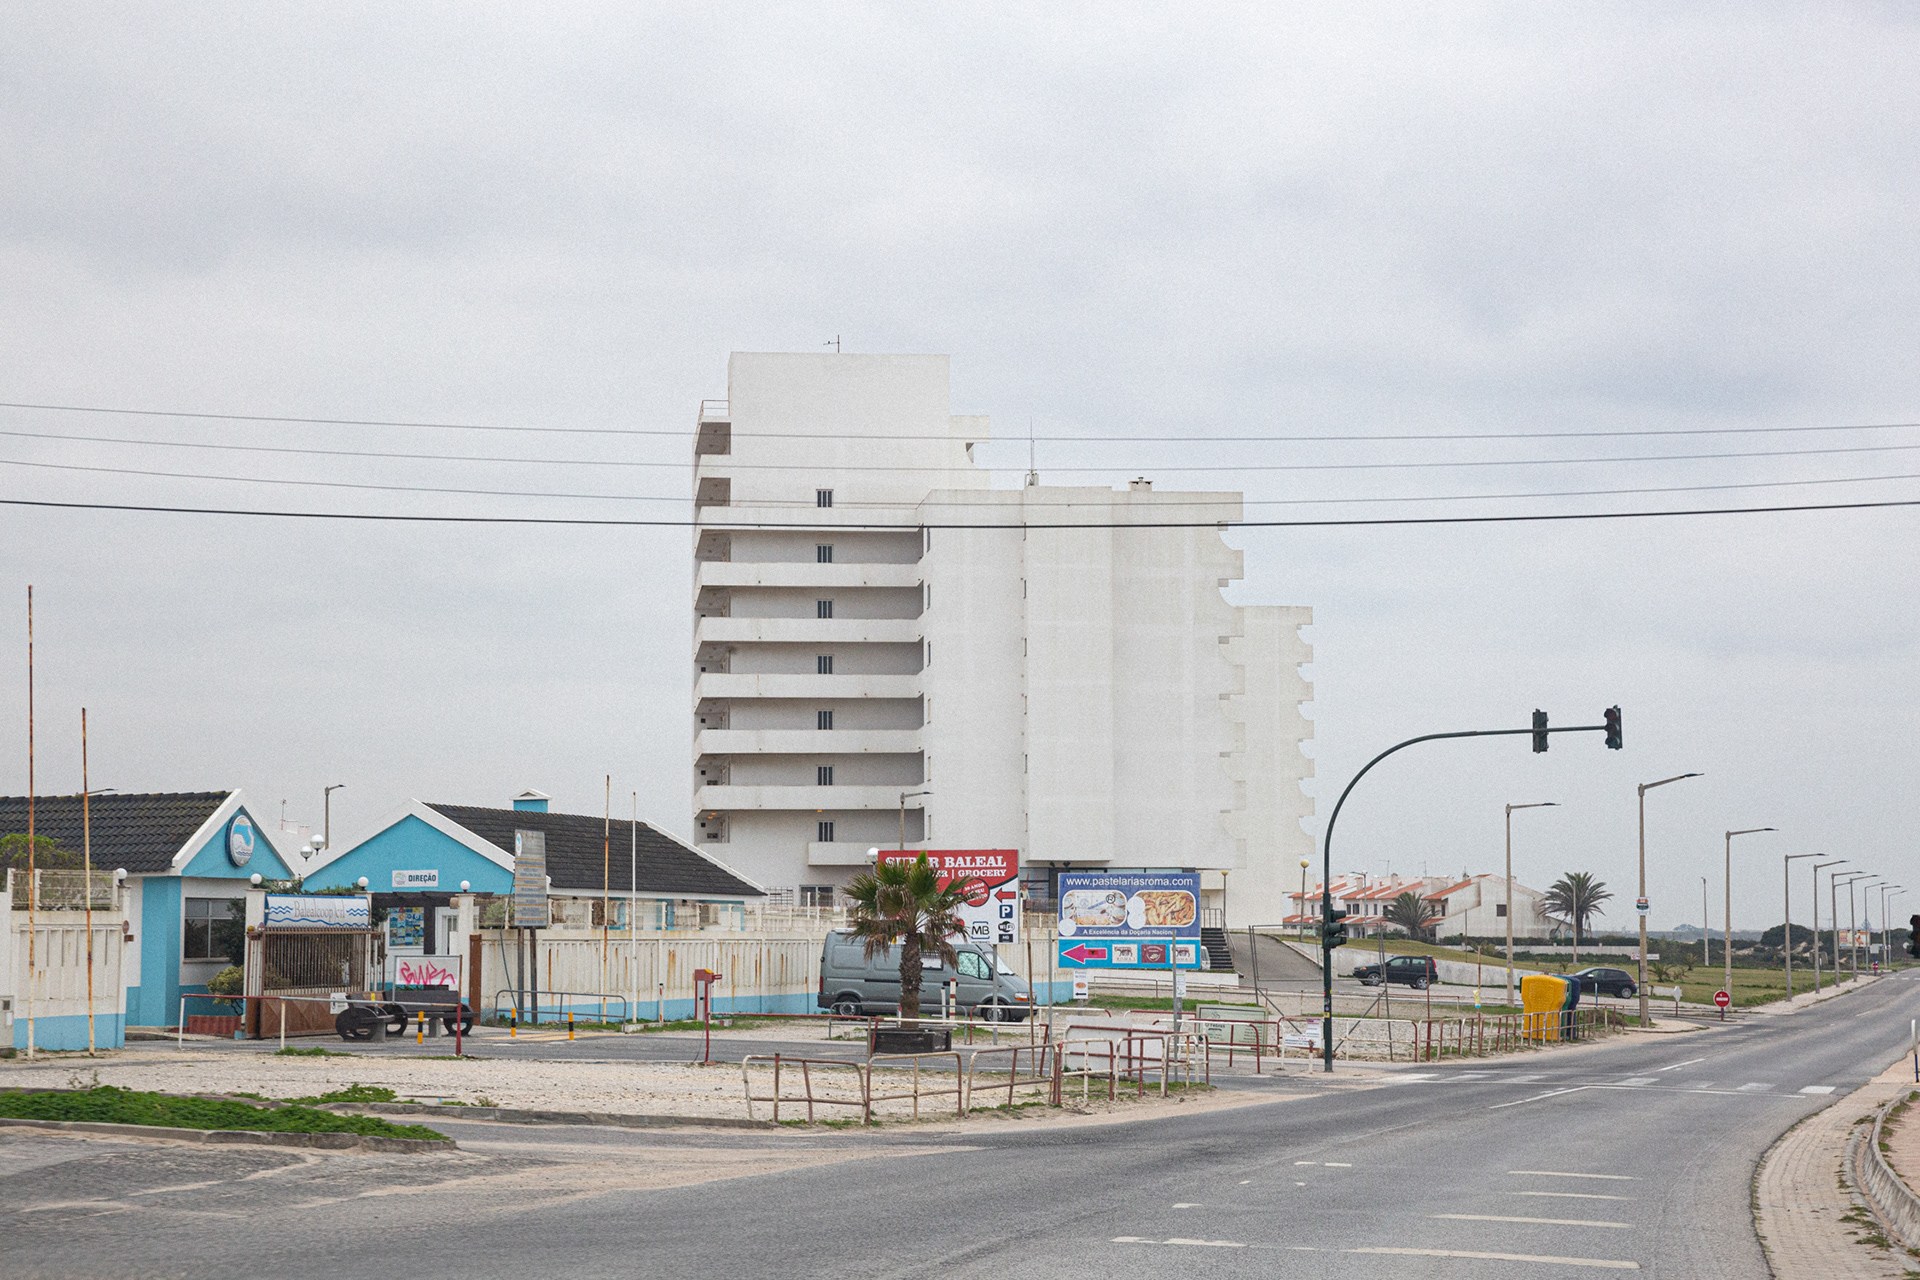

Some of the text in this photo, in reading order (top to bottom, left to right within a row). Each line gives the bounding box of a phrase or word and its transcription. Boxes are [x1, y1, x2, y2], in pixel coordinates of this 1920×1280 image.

[885, 856, 1007, 868] SUPR BALEAL
[408, 873, 437, 884] DIREÇÃO
[958, 869, 1007, 878] GROCERY
[1066, 877, 1193, 887] www.pastelariasroma.com
[1001, 906, 1011, 918] P
[971, 925, 990, 935] MB
[1129, 928, 1152, 936] Doçaria
